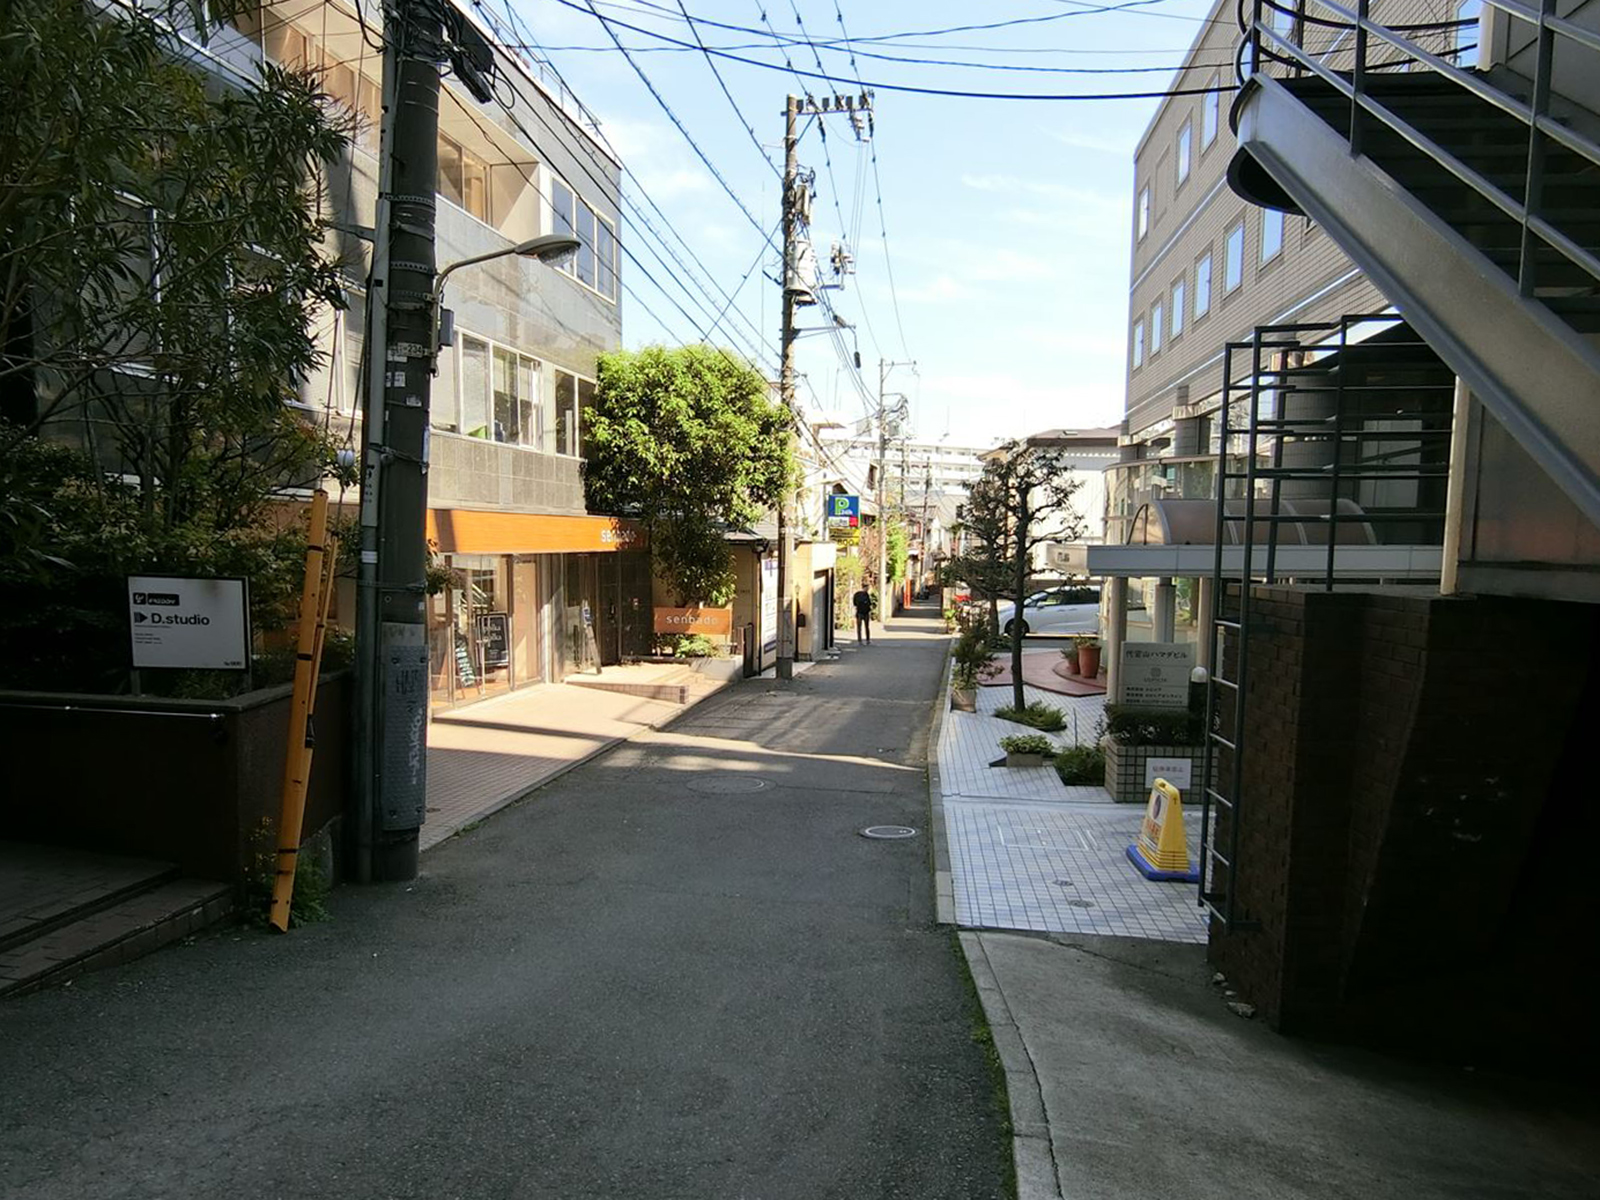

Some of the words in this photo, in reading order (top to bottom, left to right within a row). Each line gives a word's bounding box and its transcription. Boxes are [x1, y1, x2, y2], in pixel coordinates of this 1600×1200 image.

[834, 497, 850, 515] P
[151, 612, 210, 625] D.studio
[665, 614, 718, 625] senbado
